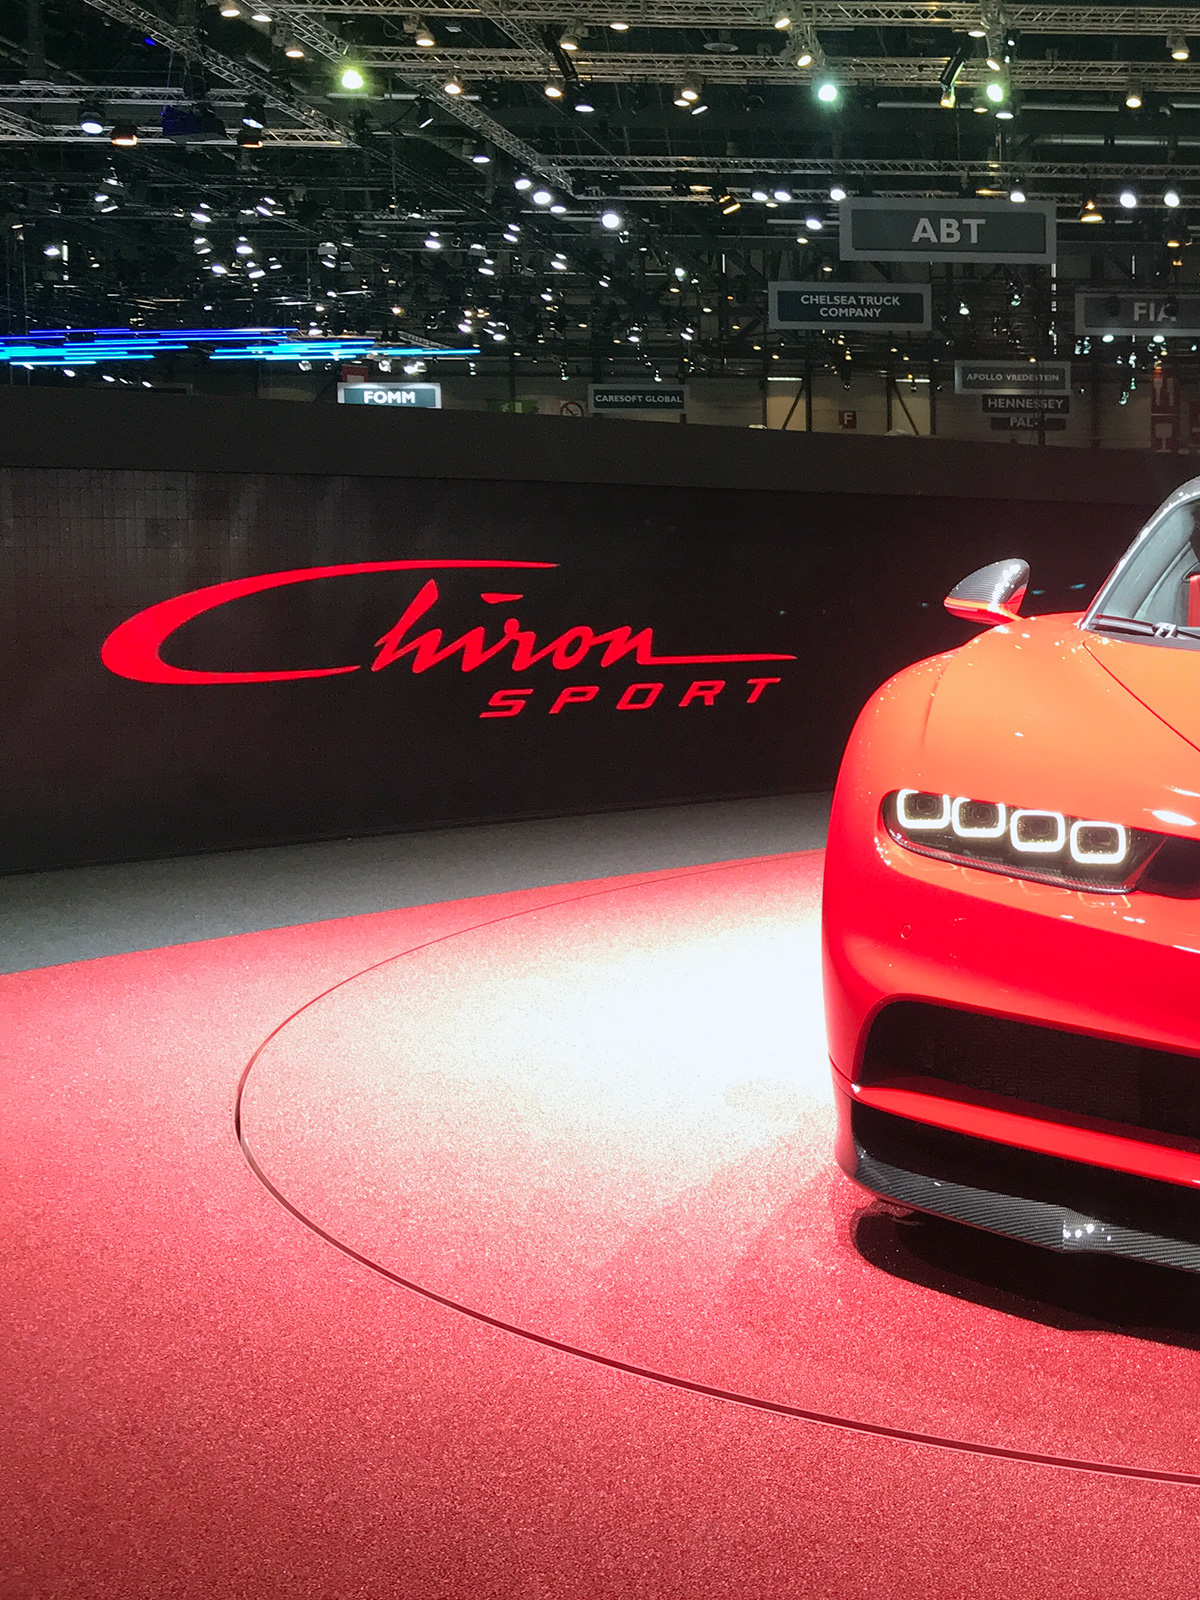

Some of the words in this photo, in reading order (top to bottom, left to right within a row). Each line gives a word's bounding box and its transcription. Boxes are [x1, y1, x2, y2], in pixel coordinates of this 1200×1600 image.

[911, 217, 986, 244] ABT
[800, 294, 856, 306] CHELSEA
[857, 296, 901, 307] TRUCK
[819, 306, 882, 319] COMPANY
[1133, 301, 1177, 322] FIA
[966, 373, 1003, 381] APOLLO
[363, 390, 416, 404] FOMM
[595, 394, 643, 403] CARESOFT
[645, 395, 682, 403] GLOBAL
[844, 412, 853, 425] F
[101, 560, 797, 685] Chiron
[479, 677, 781, 718] SPORT
